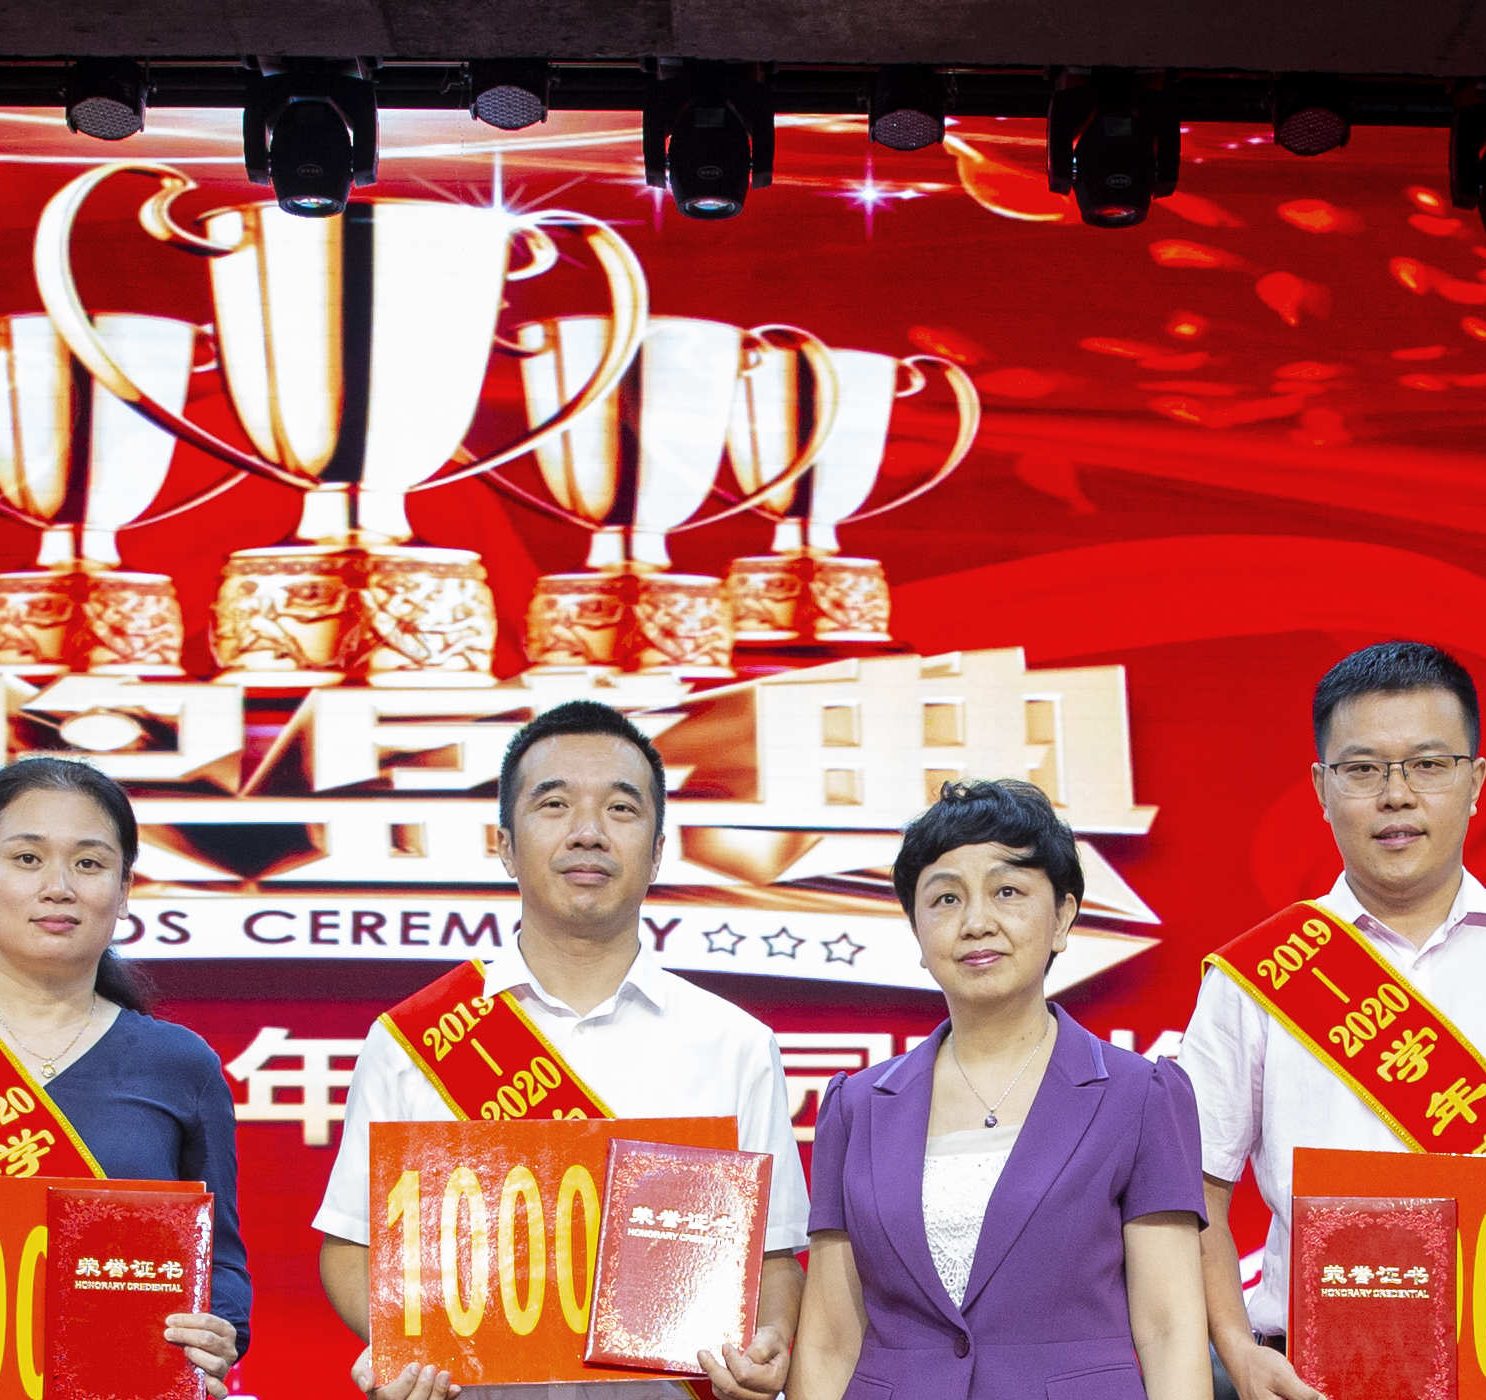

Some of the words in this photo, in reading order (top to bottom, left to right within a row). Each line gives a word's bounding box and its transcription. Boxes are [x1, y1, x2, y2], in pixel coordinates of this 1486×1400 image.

[242, 910, 683, 952] CEREMY
[1257, 918, 1332, 991] 2019
[422, 995, 495, 1062] 2019
[1328, 983, 1410, 1059] 2020
[480, 1056, 562, 1121] 2020
[75, 1257, 184, 1279] 荣誉证书
[387, 1164, 600, 1338] 1000
[1321, 1265, 1429, 1285] 荣誉证书
[75, 1280, 126, 1291] HONORARY
[126, 1282, 183, 1293] CREDENTIAL
[1321, 1288, 1372, 1298] HONORARY
[1373, 1289, 1430, 1299] CREDENTIAL
